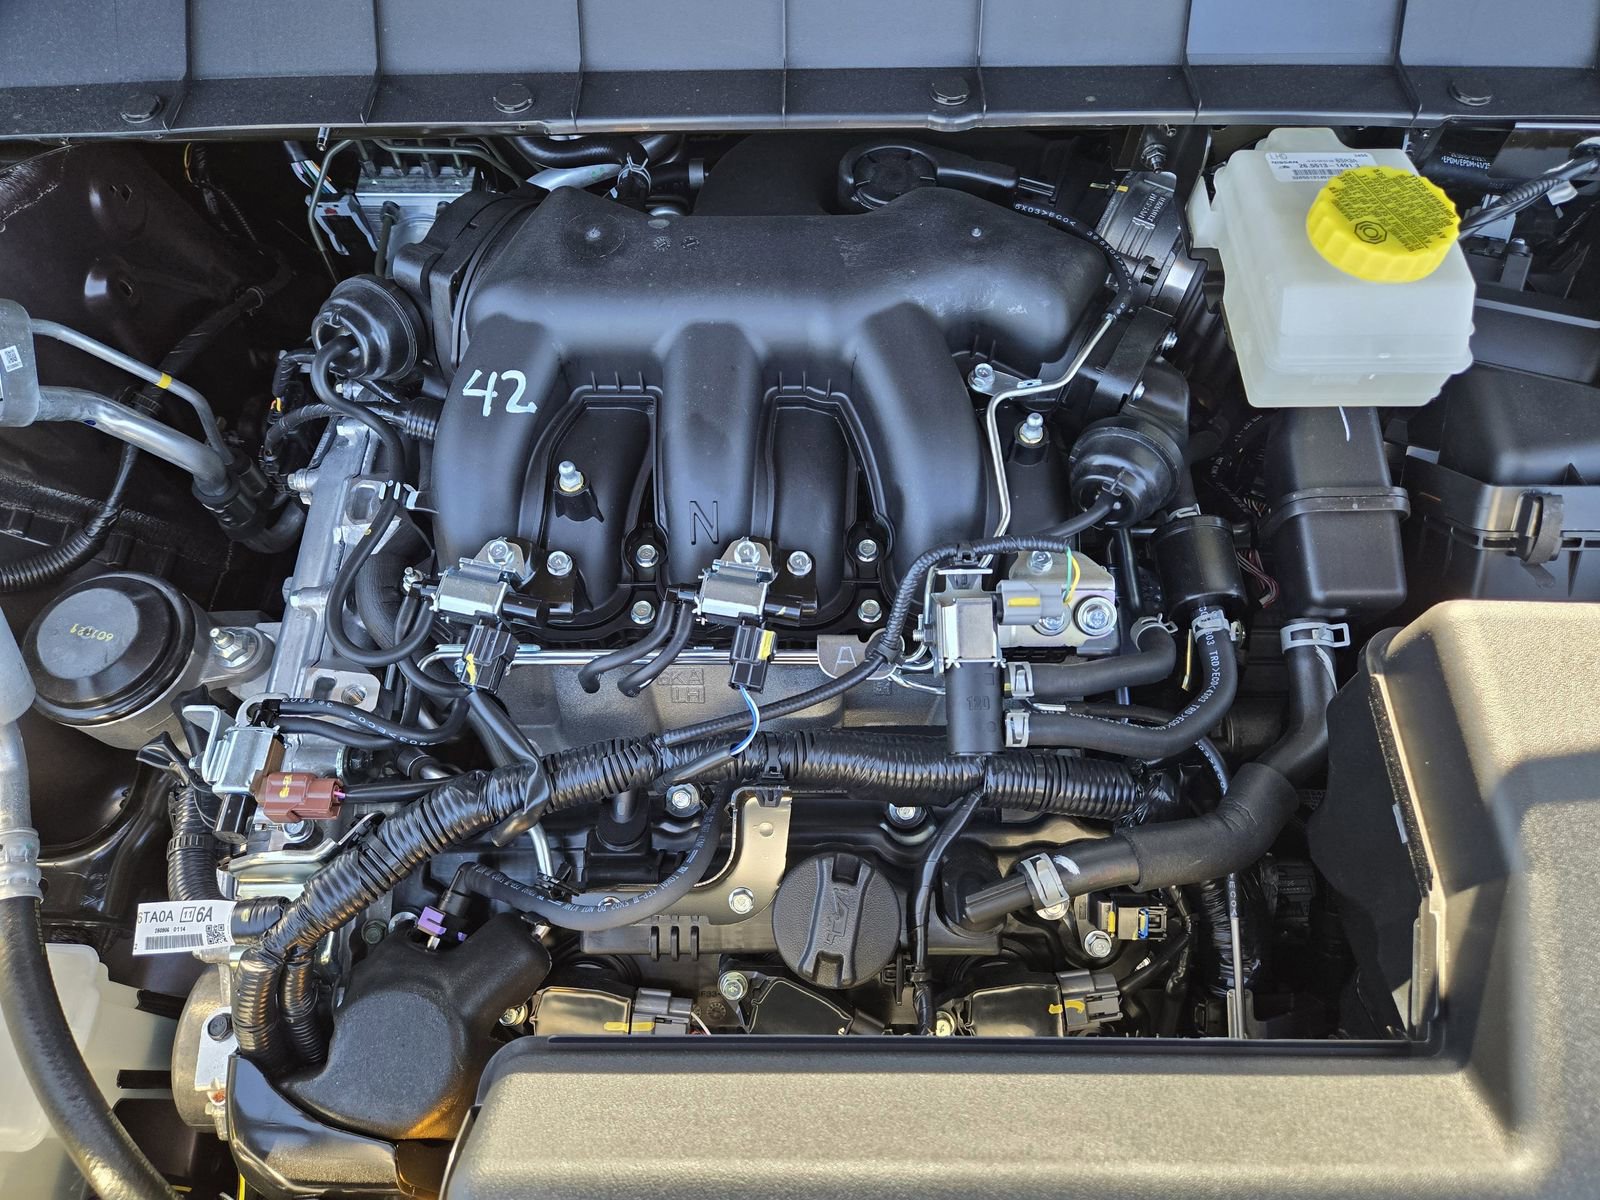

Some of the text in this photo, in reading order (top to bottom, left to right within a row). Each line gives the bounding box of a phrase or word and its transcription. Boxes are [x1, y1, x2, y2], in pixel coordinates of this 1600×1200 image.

[462, 369, 538, 417] 42
[688, 500, 720, 546] N
[832, 646, 858, 674] A
[196, 906, 213, 922] 6A
